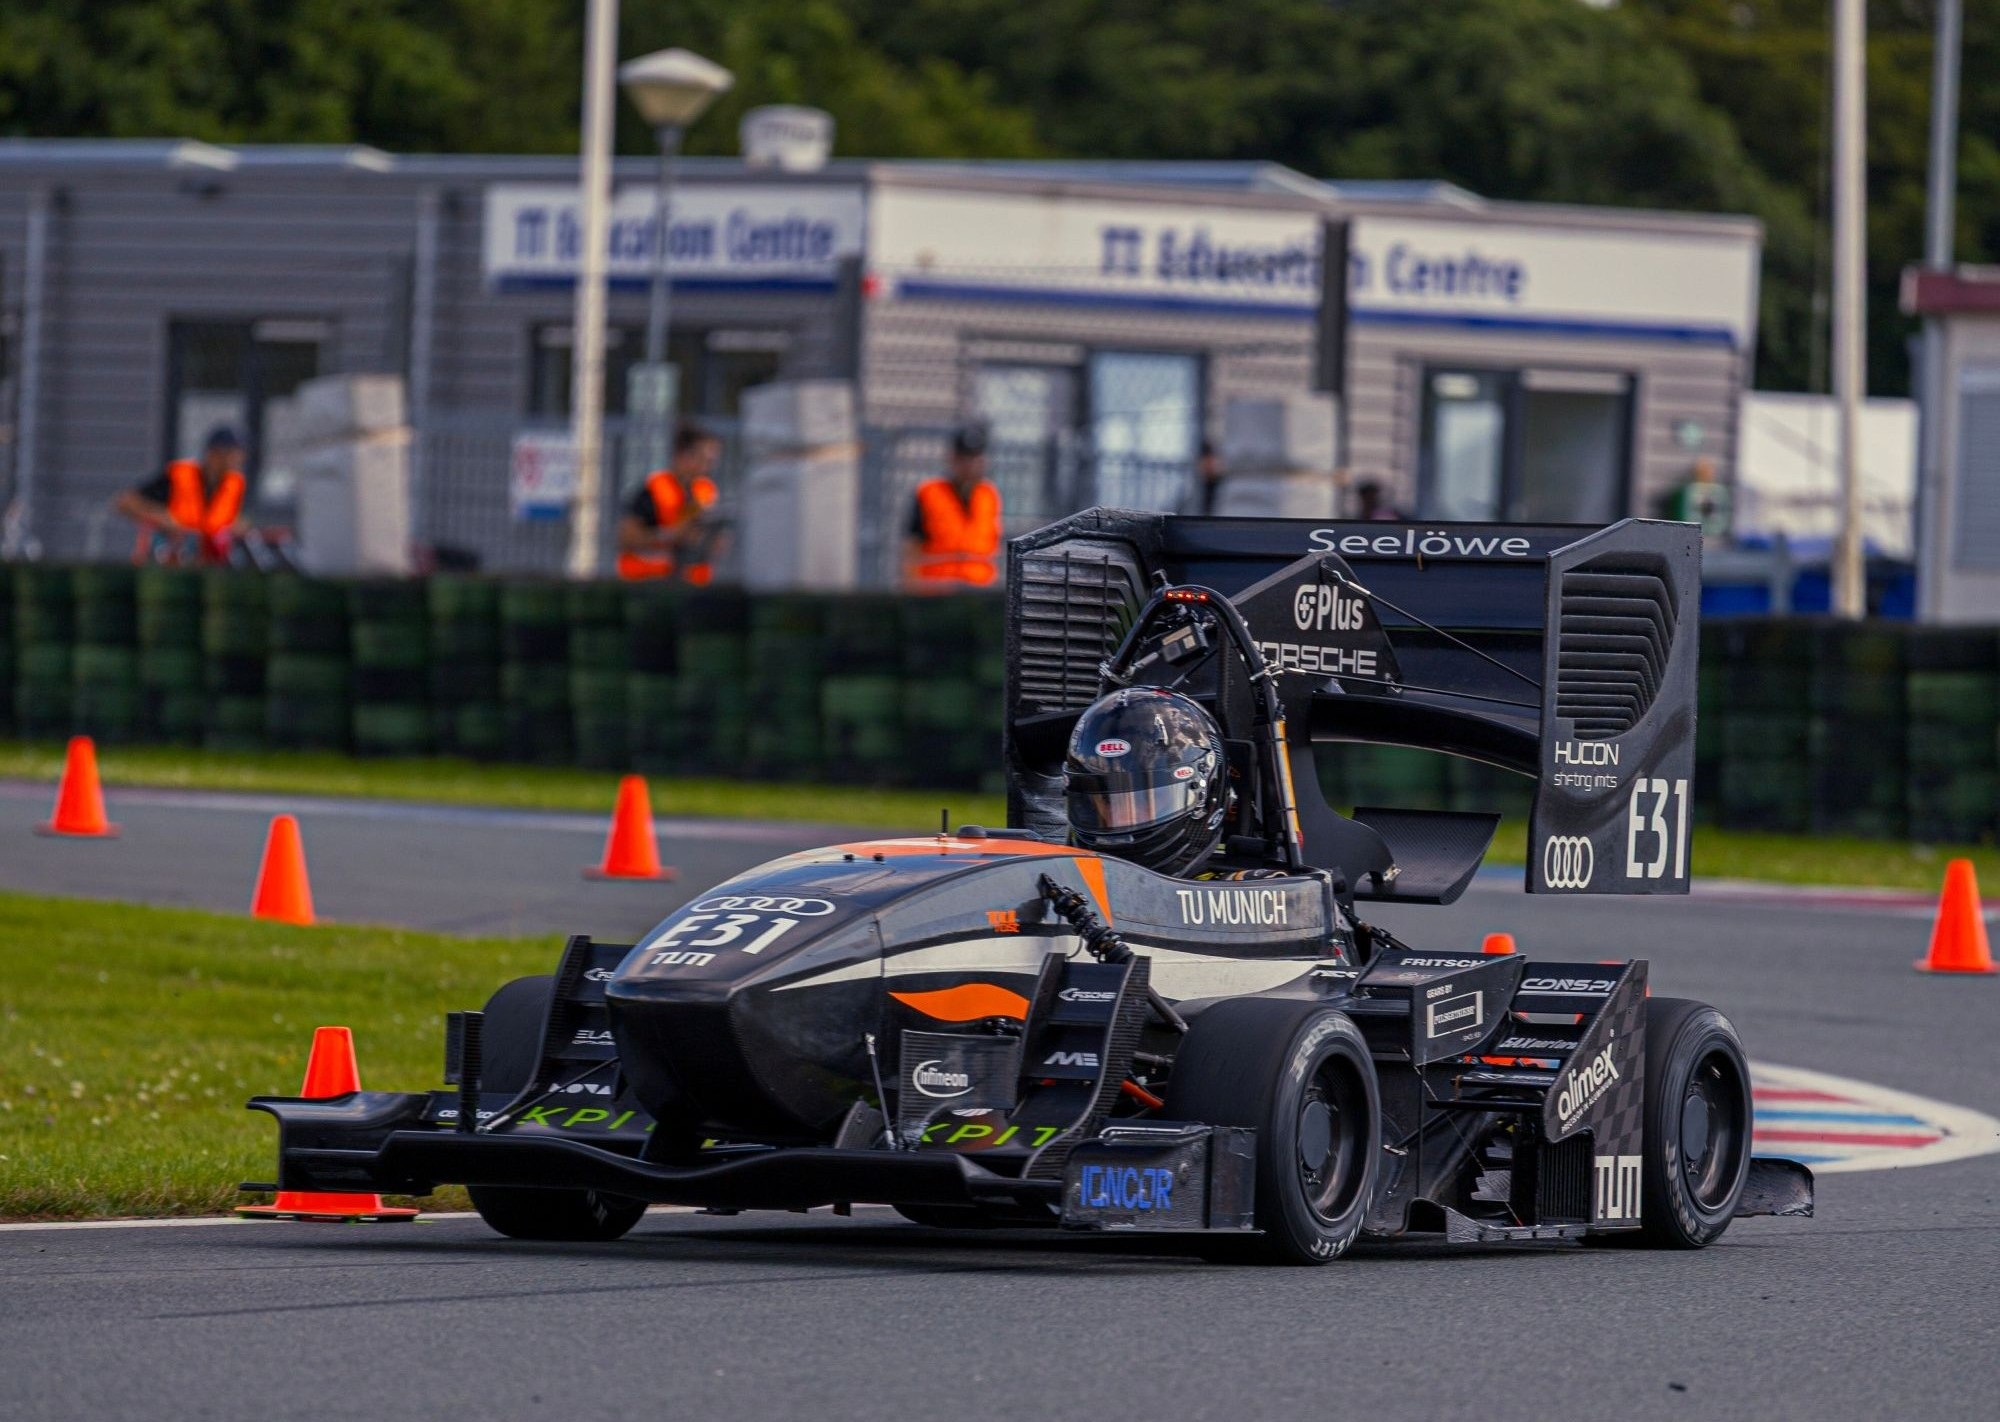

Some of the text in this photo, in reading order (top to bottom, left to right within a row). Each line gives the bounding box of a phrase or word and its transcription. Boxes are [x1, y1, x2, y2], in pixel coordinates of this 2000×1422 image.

[1386, 241, 1526, 297] Centre
[1307, 528, 1531, 556] Seelöwe
[1626, 778, 1688, 878] E31
[1176, 890, 1287, 925] TU MUNICH
[646, 914, 800, 955] E31
[650, 952, 717, 966] TUM
[1557, 1043, 1619, 1121] alimex
[1595, 1155, 1642, 1218] TUM
